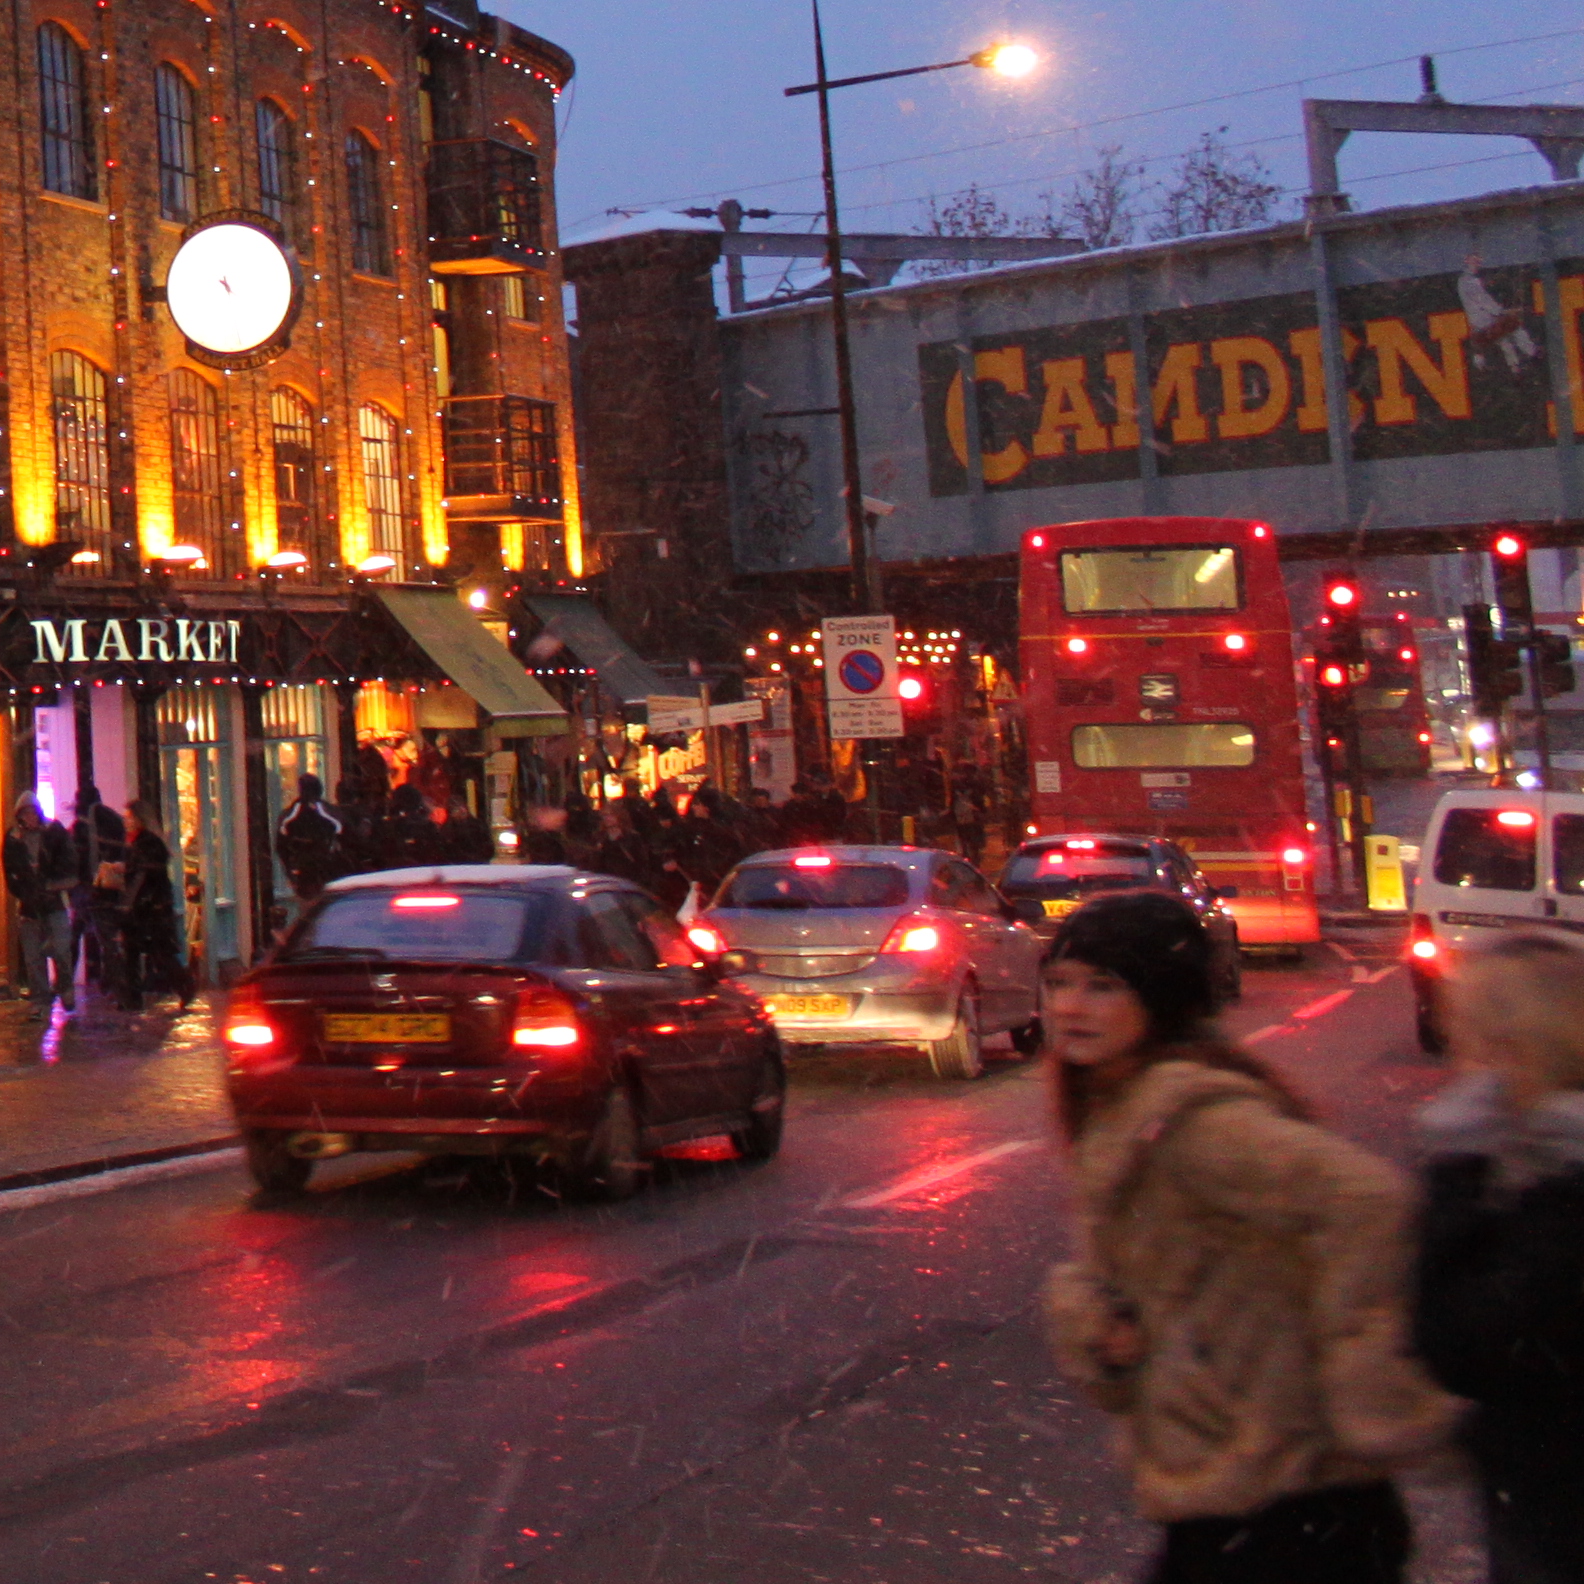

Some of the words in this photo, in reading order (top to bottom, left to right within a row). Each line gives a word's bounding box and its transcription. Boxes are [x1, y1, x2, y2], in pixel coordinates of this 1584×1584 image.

[944, 310, 1474, 486] CAMDEN
[827, 619, 890, 631] Controlled
[837, 633, 882, 646] ZONE
[30, 618, 241, 664] MARKET
